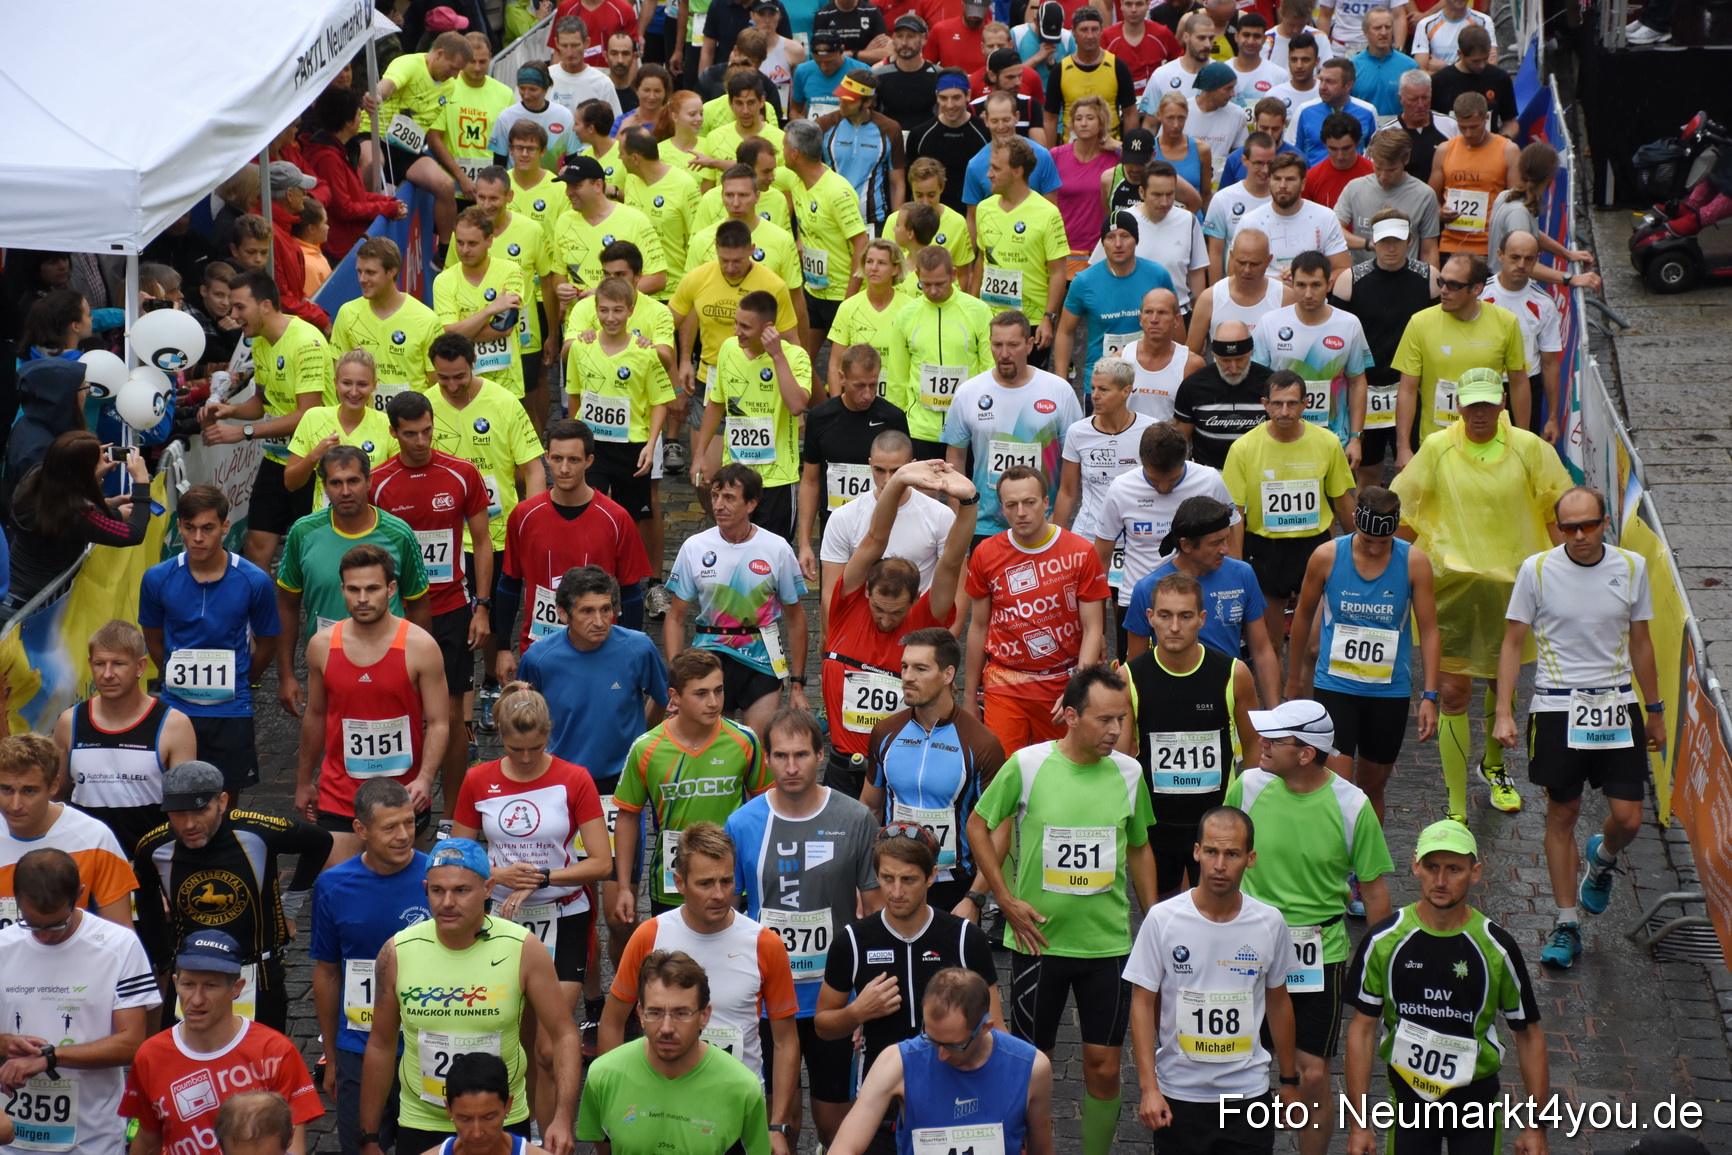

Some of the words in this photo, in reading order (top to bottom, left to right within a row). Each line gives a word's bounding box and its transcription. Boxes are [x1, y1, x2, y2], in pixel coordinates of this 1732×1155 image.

[326, 2, 363, 57] Neumarkt
[459, 107, 487, 118] Müller
[392, 122, 422, 150] 2890
[466, 125, 480, 140] M
[1453, 200, 1479, 217] 122
[985, 278, 1018, 296] 2824
[480, 357, 499, 367] Gerrit
[930, 376, 959, 395] 187
[933, 396, 952, 407] David
[585, 402, 626, 426] 2866
[593, 426, 613, 436] Jonas
[731, 428, 770, 446] 2826
[740, 450, 761, 458] Pascal
[993, 453, 1037, 472] 2011
[837, 476, 870, 496] 164
[1268, 491, 1316, 513] 2010
[1278, 516, 1306, 526] Damian
[1340, 600, 1394, 616] ERDINGER
[1344, 638, 1384, 664] 606
[173, 663, 226, 686] 3111
[856, 687, 898, 712] 269
[1576, 705, 1627, 728] 2918
[350, 731, 403, 757] 3151
[1180, 732, 1214, 742] BOCK
[1586, 731, 1616, 743] Markus
[363, 758, 383, 770] Tom
[1158, 745, 1216, 770] 2416
[86, 773, 115, 781] Autohaus
[1173, 775, 1201, 787] Ronny
[659, 776, 738, 800] BOCK
[230, 808, 287, 827] Continental
[916, 810, 949, 820] BOCK
[1076, 829, 1110, 839] BOCK
[1057, 843, 1100, 869] 251
[180, 870, 243, 896] CONTINENTAL
[1069, 875, 1089, 886] Udo
[790, 911, 828, 924] BOCK
[1289, 929, 1316, 938] OCK
[790, 960, 813, 970] artin
[1173, 963, 1192, 971] PARTL
[1286, 974, 1305, 983] mas
[5, 985, 36, 995] weidinger
[36, 984, 71, 994] versichert.
[1424, 988, 1453, 1001] DAV
[1210, 992, 1248, 1003] BOCK
[56, 1004, 80, 1012] Jürgen
[407, 1007, 451, 1017] BANGKOK
[454, 1007, 500, 1018] RUNNERS
[1191, 1007, 1240, 1035] 168
[701, 1028, 736, 1038] BOCK
[453, 1035, 496, 1047] BOCK
[1194, 1040, 1235, 1053] Michael
[1407, 1043, 1458, 1080] 305
[30, 1078, 72, 1089] BOCK
[173, 1073, 209, 1093] raumbox
[1412, 1076, 1442, 1096] Ralph
[4, 1088, 71, 1123] 2359
[954, 1100, 979, 1120] RUN
[14, 1125, 50, 1141] Jürgen
[952, 1127, 996, 1140] BOCK
